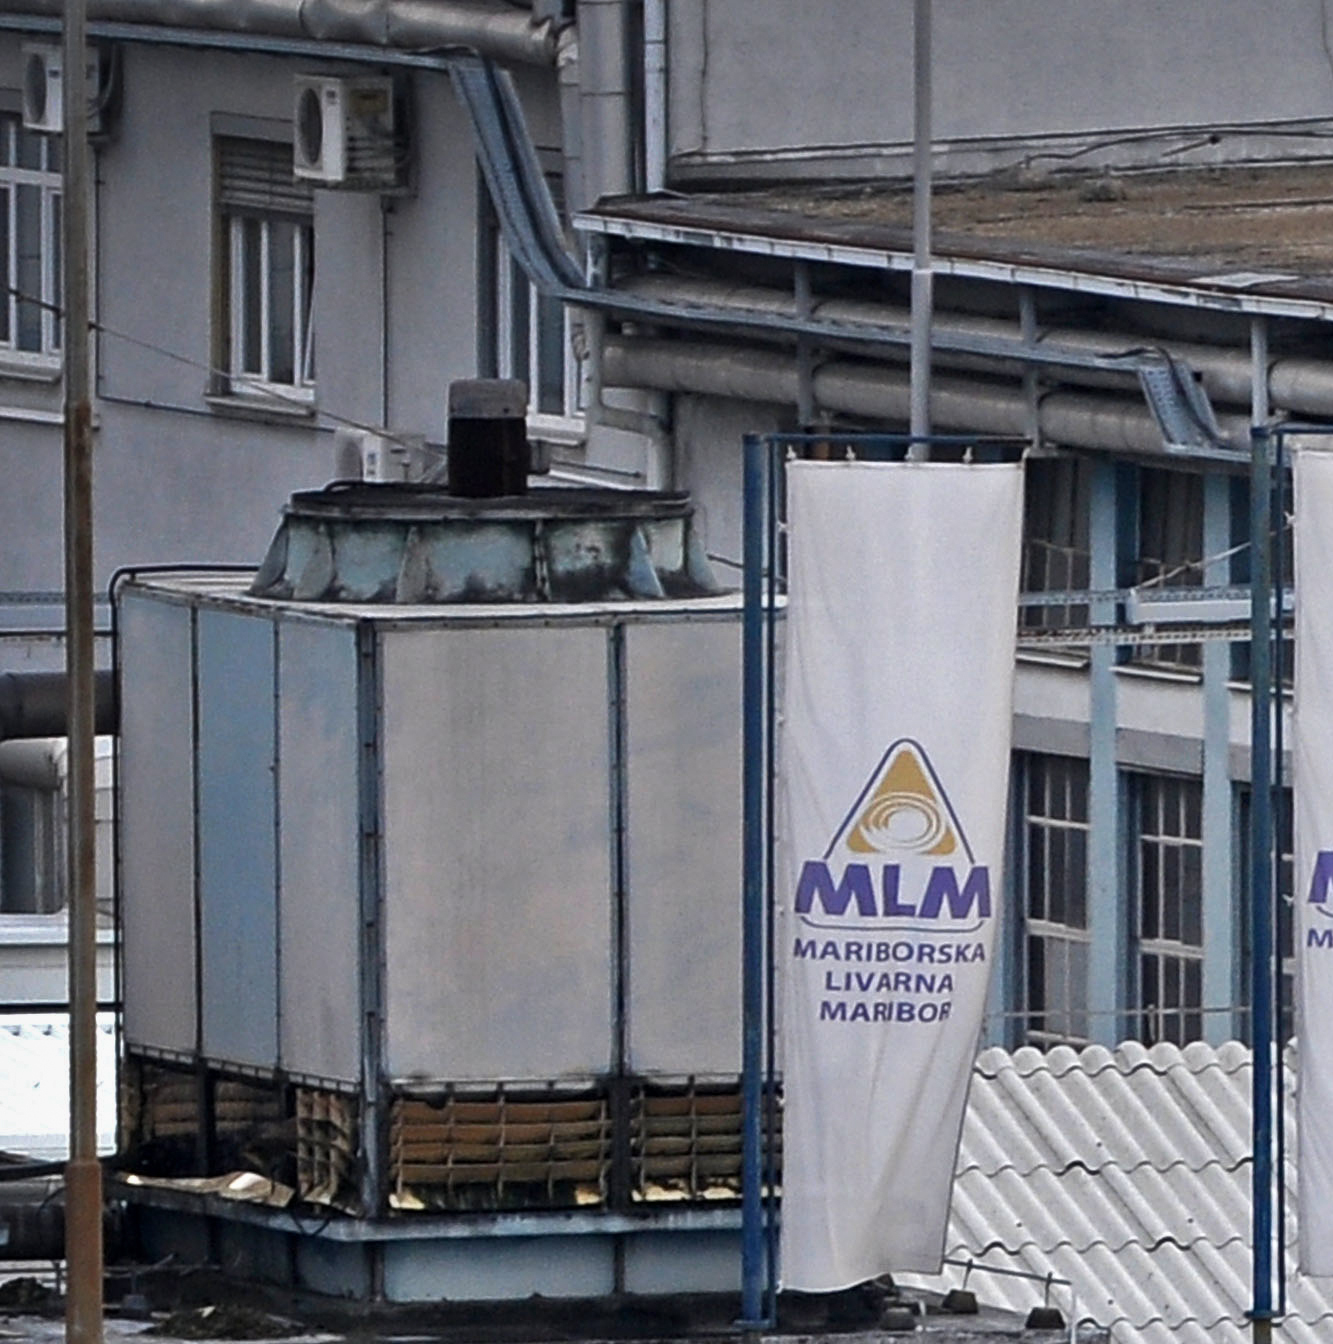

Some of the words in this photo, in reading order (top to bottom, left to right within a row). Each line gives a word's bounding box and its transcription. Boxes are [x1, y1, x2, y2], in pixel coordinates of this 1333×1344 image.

[794, 860, 992, 919] MLM
[793, 937, 986, 963] MARIBORSKA
[824, 970, 954, 994] LIVARNA
[819, 1000, 952, 1023] MARIBOR
